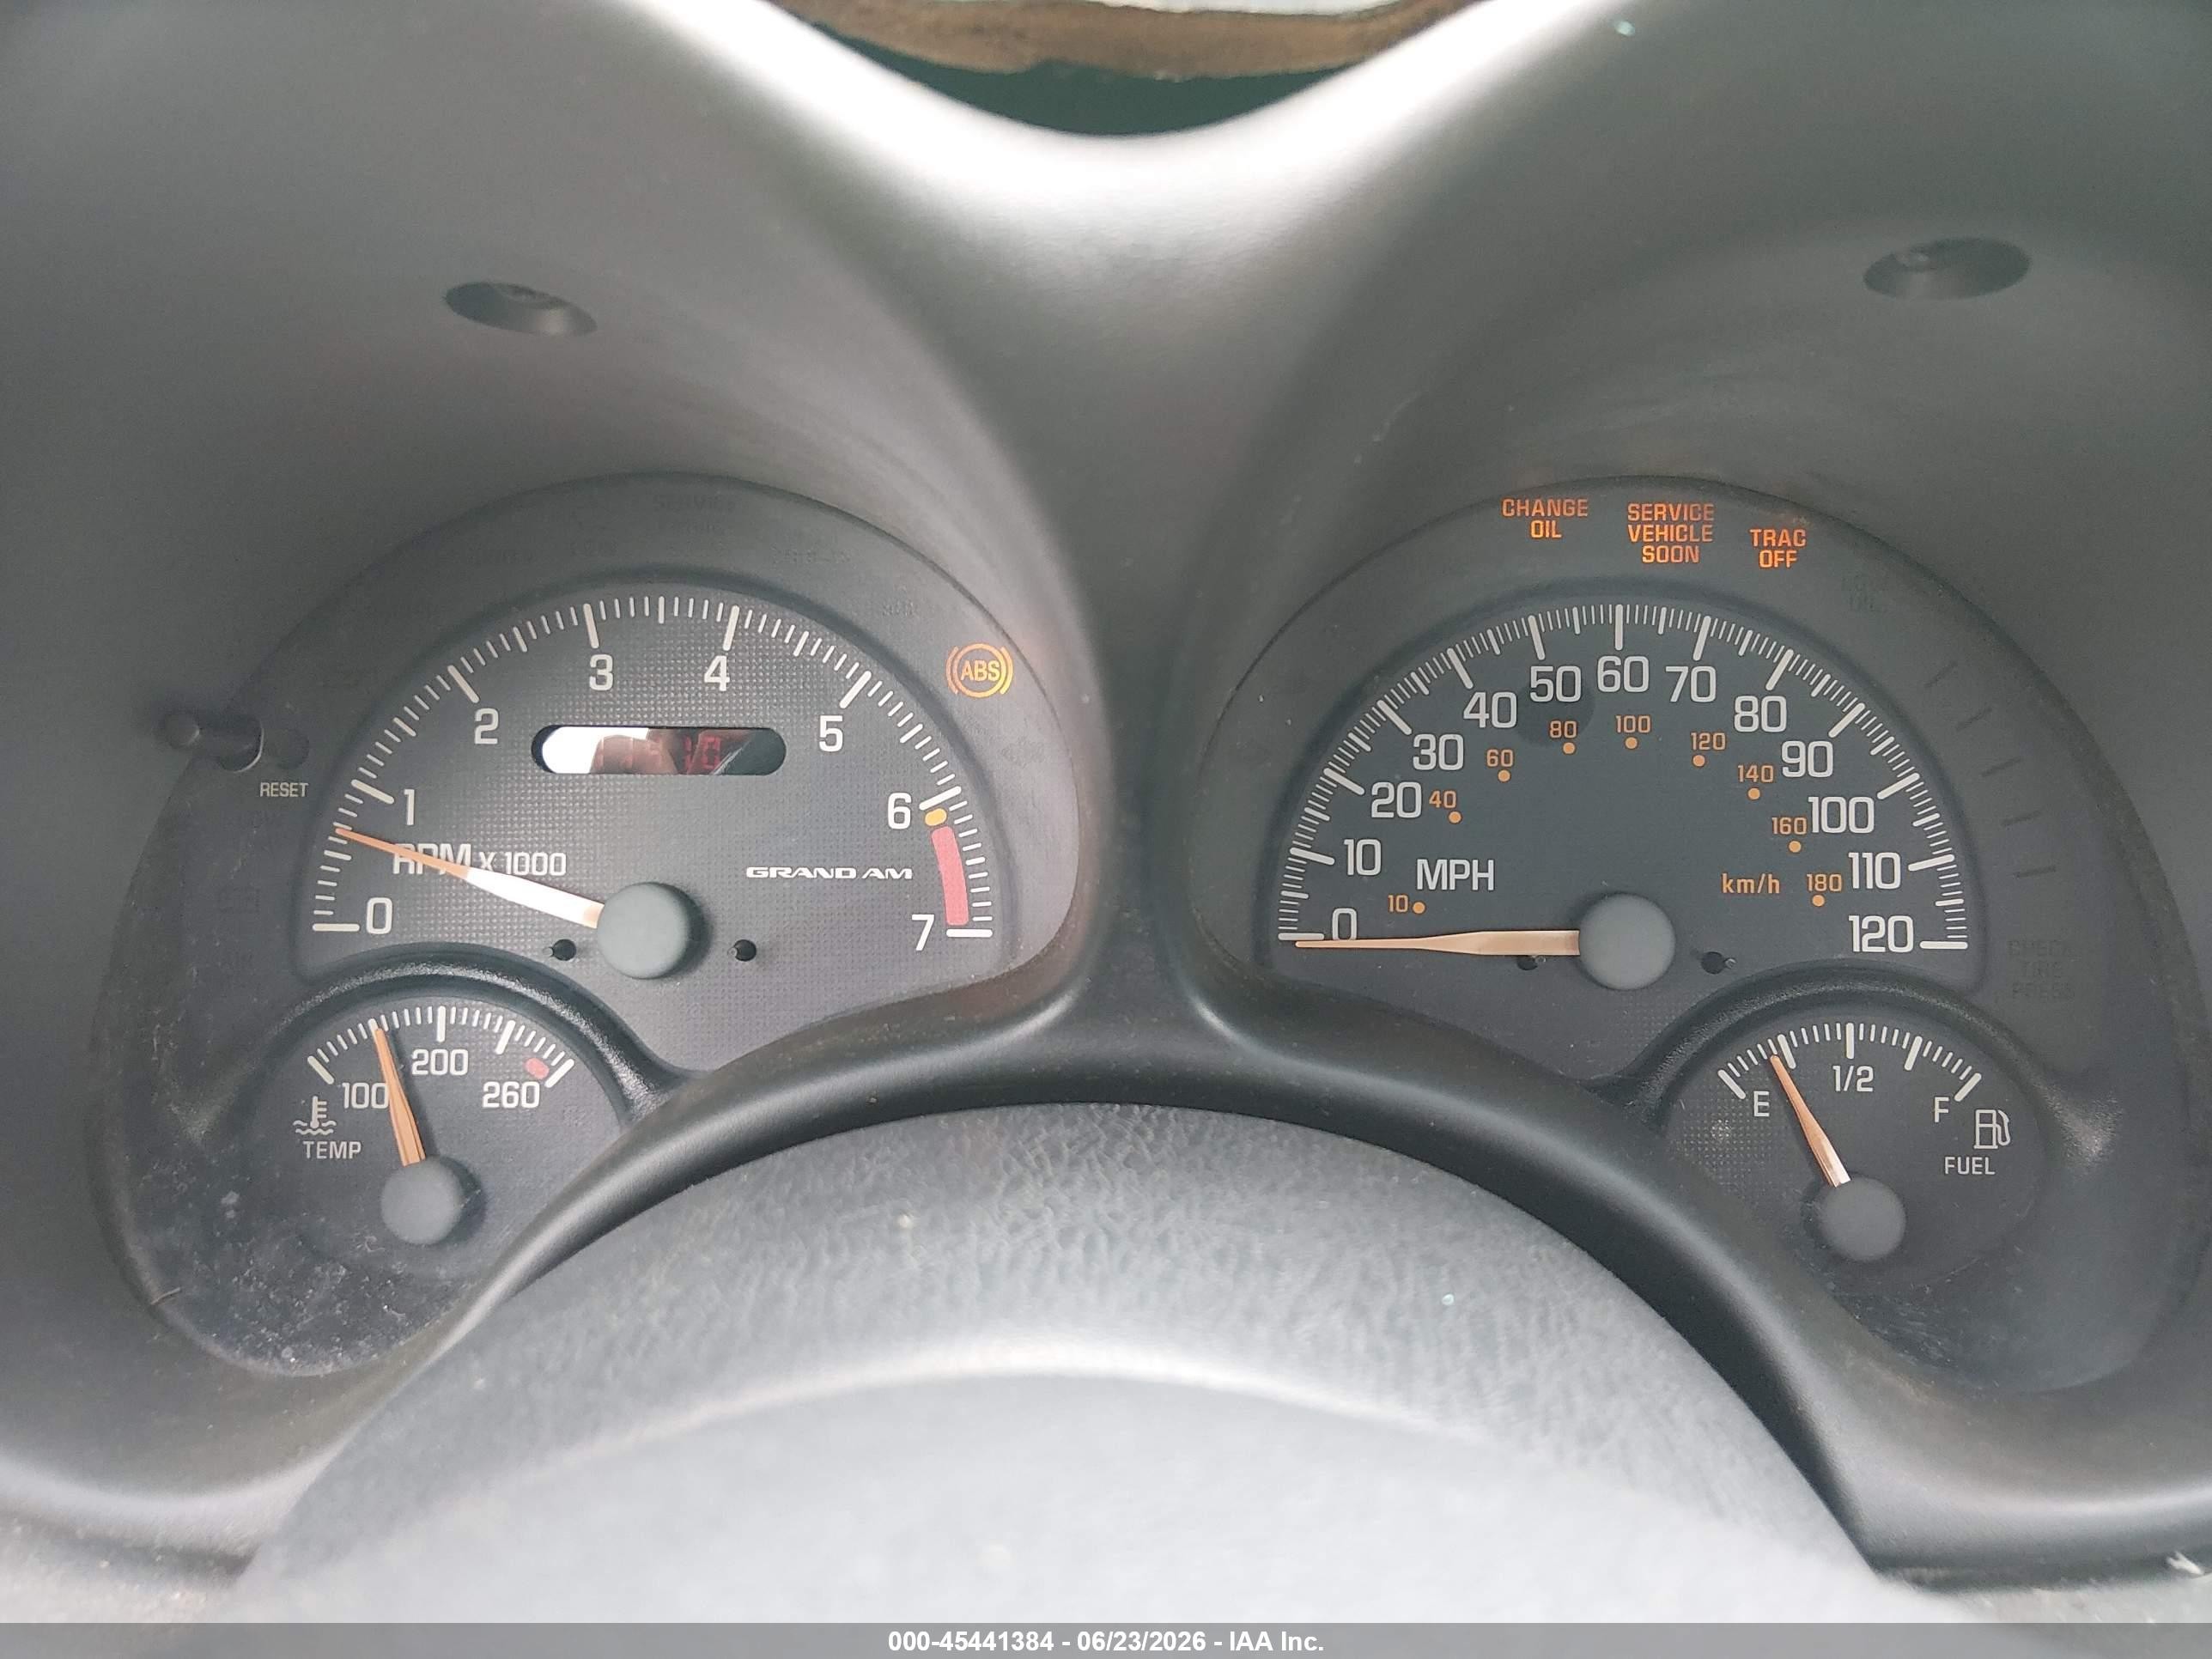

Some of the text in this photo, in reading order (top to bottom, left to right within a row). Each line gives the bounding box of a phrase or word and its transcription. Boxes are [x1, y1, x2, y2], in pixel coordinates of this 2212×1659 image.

[1501, 498, 1589, 518] CHANGE
[1626, 502, 1715, 522] SERVICE
[1530, 520, 1562, 538] OIL
[1626, 524, 1713, 543] VEHICLE
[1749, 528, 1806, 547] TRAC
[1642, 544, 1699, 563] SOON
[1759, 549, 1797, 568] OFF
[588, 653, 614, 691] 3
[703, 655, 731, 692] 4
[960, 659, 1001, 684] ABS
[1529, 665, 1582, 702] 50
[1597, 655, 1650, 693] 60
[1665, 665, 1717, 702] 70
[1463, 691, 1517, 728] 40
[1734, 695, 1787, 732] 80
[474, 708, 499, 744] 2
[818, 714, 843, 752] 5
[1549, 720, 1577, 738] 80
[1615, 715, 1651, 733] 100
[1413, 733, 1464, 771] 30
[1691, 732, 1726, 750] 120
[1486, 749, 1514, 768] 60
[1781, 740, 1834, 778] 90
[1737, 764, 1774, 783] 140
[259, 781, 309, 798] RESET
[1370, 781, 1422, 818] 20
[1429, 790, 1456, 809] 40
[404, 788, 415, 826] 1
[887, 792, 912, 830] 6
[1808, 796, 1875, 834] 100
[1771, 817, 1808, 835] 160
[392, 842, 471, 875] RPM
[503, 851, 568, 877] 1000
[1343, 838, 1382, 876] 10
[1848, 852, 1901, 890] 110
[745, 866, 913, 879] GRAND AM
[1416, 859, 1495, 891] MPH
[1722, 872, 1780, 894] km/h
[1806, 873, 1842, 892] 180
[366, 896, 393, 935] 0
[1388, 894, 1408, 913] 10
[911, 914, 935, 951] 7
[1332, 907, 1358, 940] 0
[1848, 915, 1914, 953] 120
[411, 1048, 469, 1076] 200
[1832, 1065, 1874, 1092] 1/2
[342, 1081, 389, 1110] 100
[482, 1081, 540, 1109] 260
[1753, 1091, 1770, 1117] E
[1934, 1097, 1950, 1123] F
[302, 1140, 362, 1159] TEMP
[1944, 1156, 1996, 1176] FUEL
